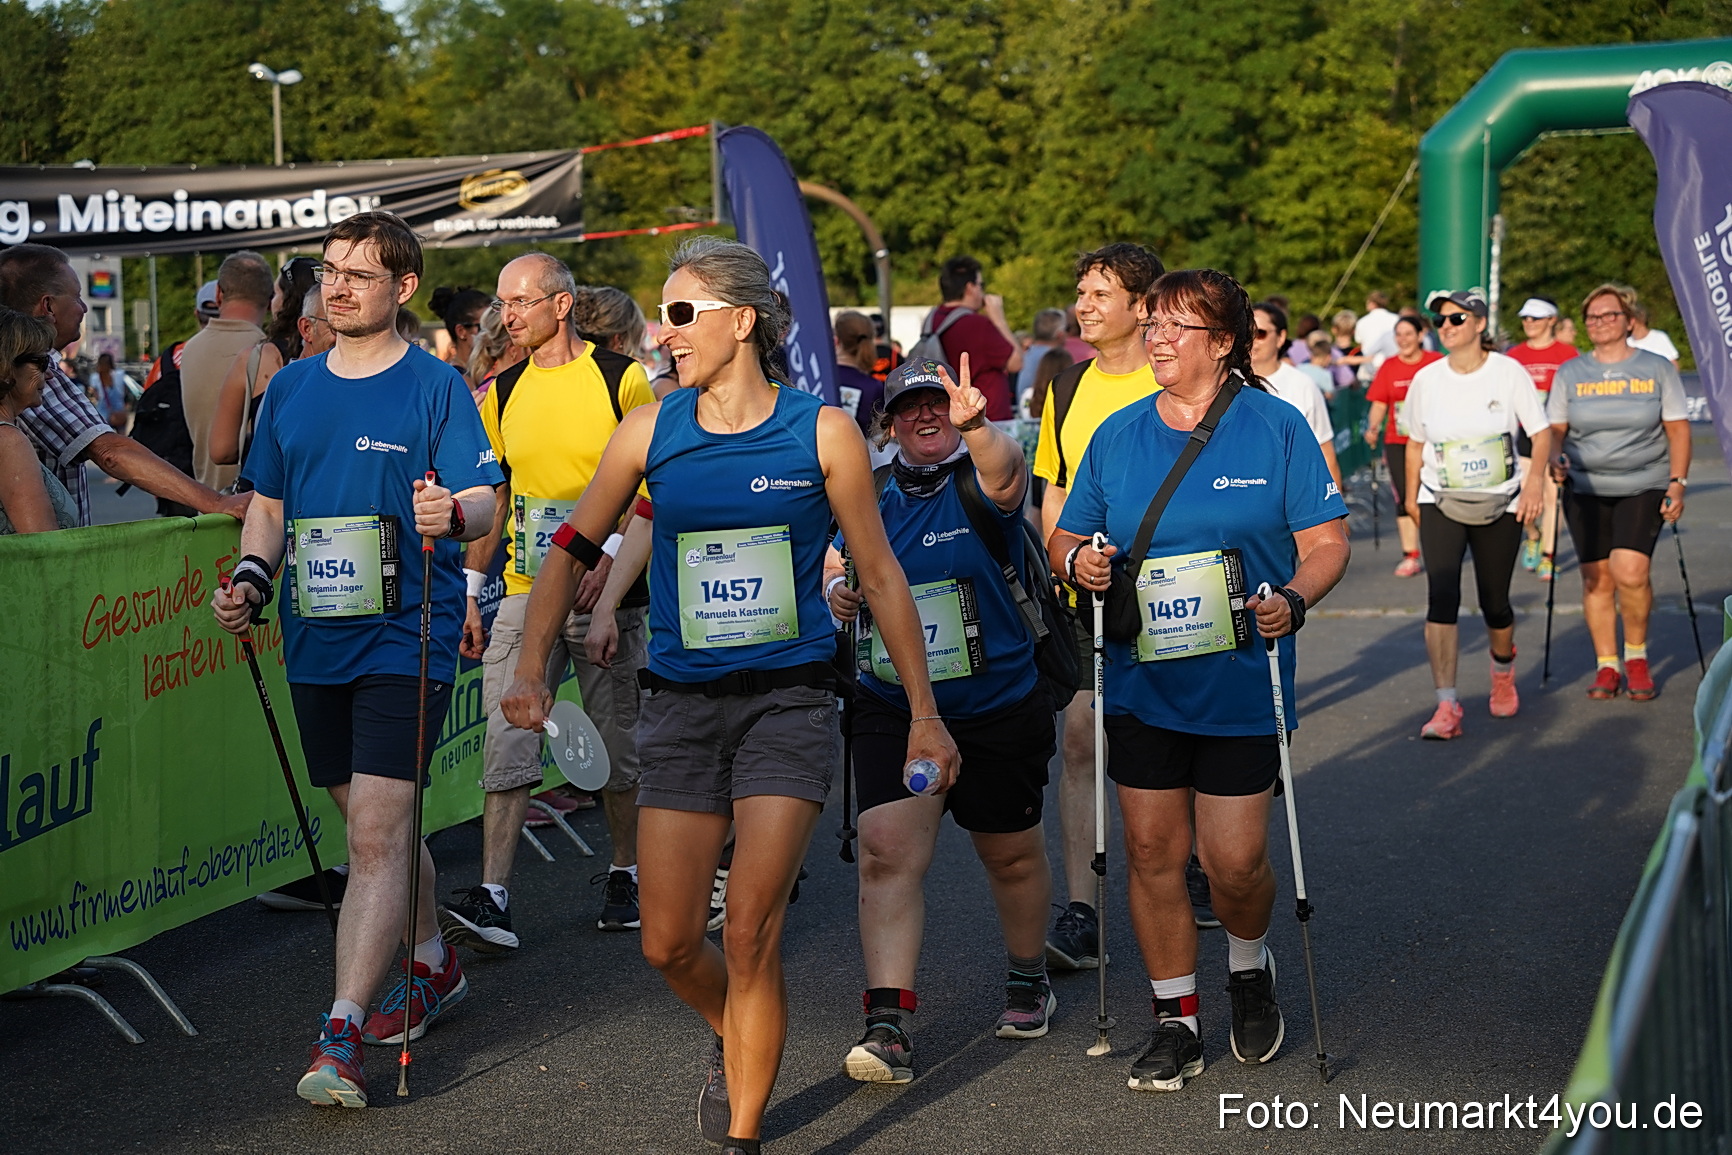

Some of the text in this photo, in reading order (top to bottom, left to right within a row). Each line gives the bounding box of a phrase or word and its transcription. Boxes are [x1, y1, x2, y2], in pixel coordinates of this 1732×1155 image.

[370, 439, 409, 454] Lebenshilfe
[1461, 459, 1488, 472] 709
[770, 478, 813, 488] Lebenshilfe
[1230, 477, 1268, 486] Lebenshilfe
[702, 552, 736, 562] Firmenlauf
[1222, 555, 1231, 579] RABATT
[306, 558, 356, 580] 1454
[307, 583, 364, 594] Benjamin Jager
[386, 578, 394, 607] HILTL
[478, 575, 504, 604] sch
[701, 577, 763, 603] 1457
[957, 584, 967, 606] RABATT
[695, 607, 780, 620] Manuela Kastner
[1147, 596, 1202, 622] 1487
[924, 624, 938, 644] 7
[1148, 621, 1214, 636] Susanne Reiser
[1235, 612, 1246, 641] HILTL
[143, 625, 227, 700] laufen
[927, 646, 960, 657] ermann
[970, 639, 980, 668] HILTL
[0, 717, 103, 852] lauf
